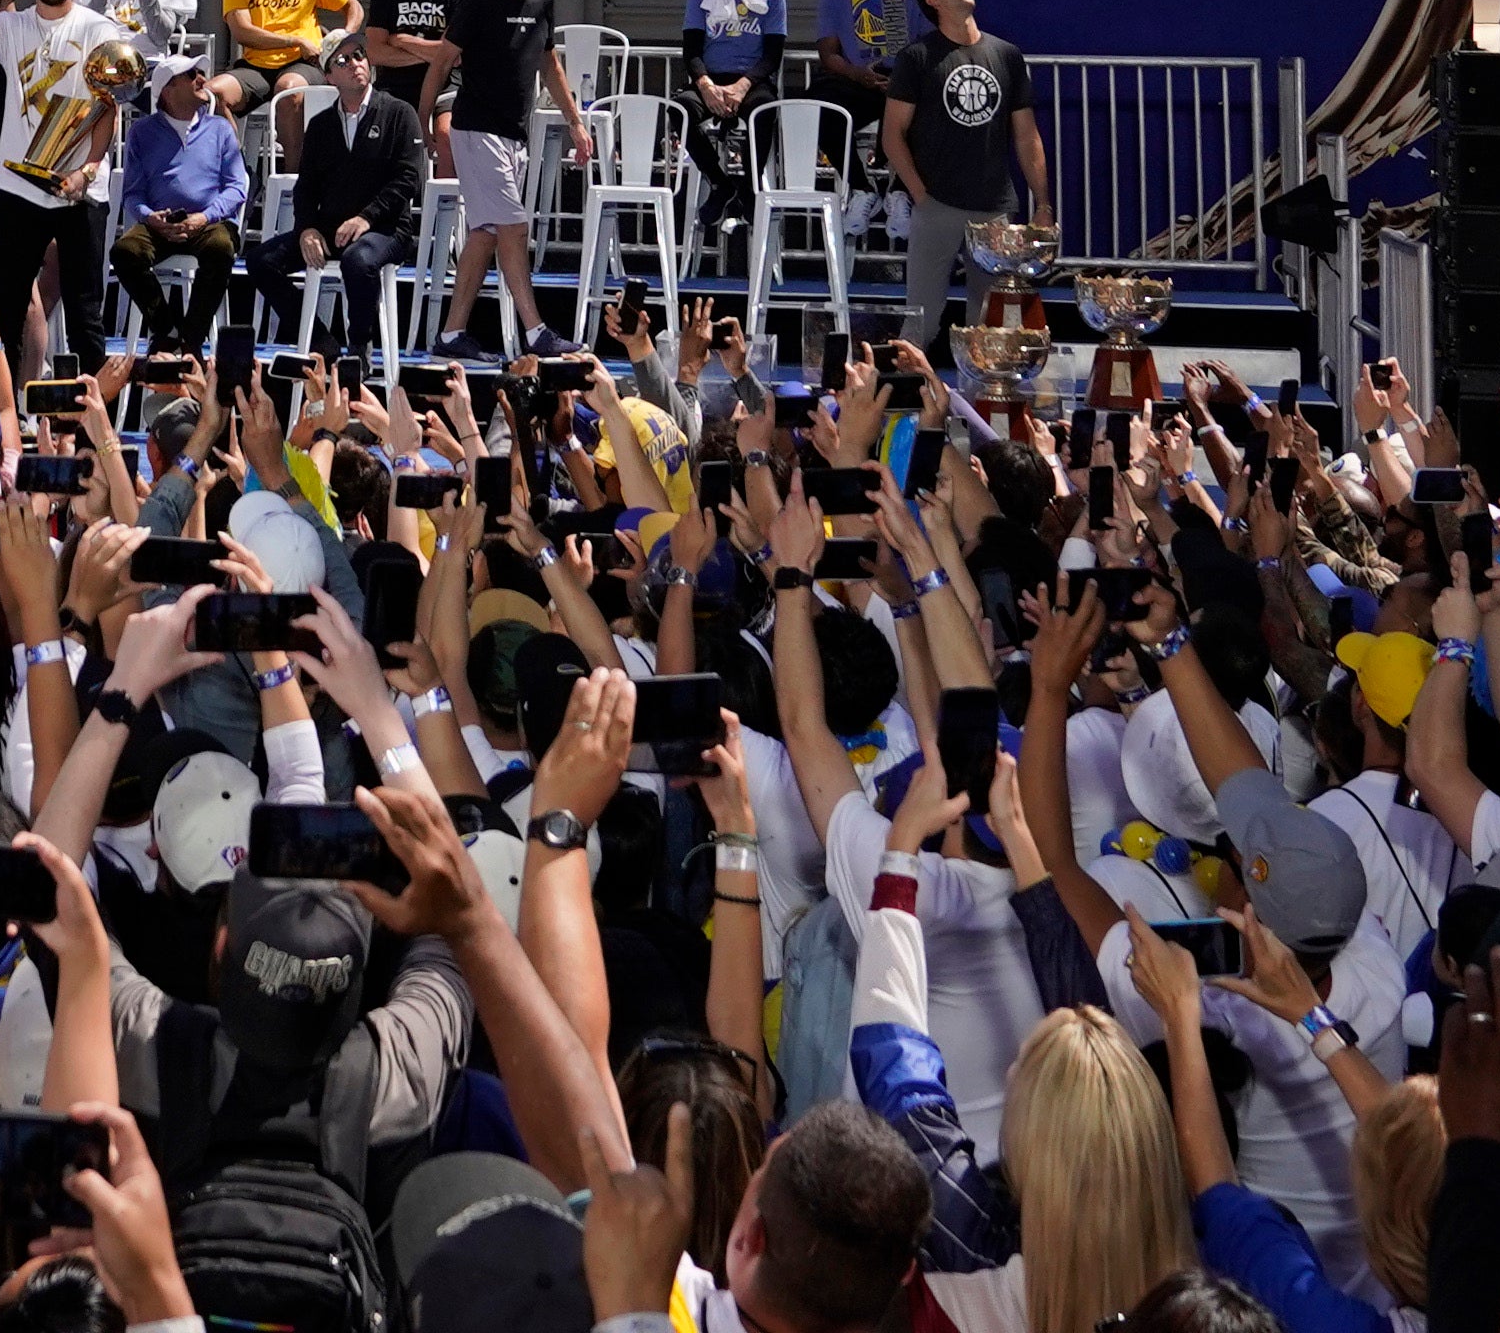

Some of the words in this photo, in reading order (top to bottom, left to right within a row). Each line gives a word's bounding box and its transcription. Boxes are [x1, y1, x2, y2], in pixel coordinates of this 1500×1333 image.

[398, 1, 445, 17] BACK
[396, 14, 446, 28] AGAIN
[243, 940, 353, 993] CHAMPS
